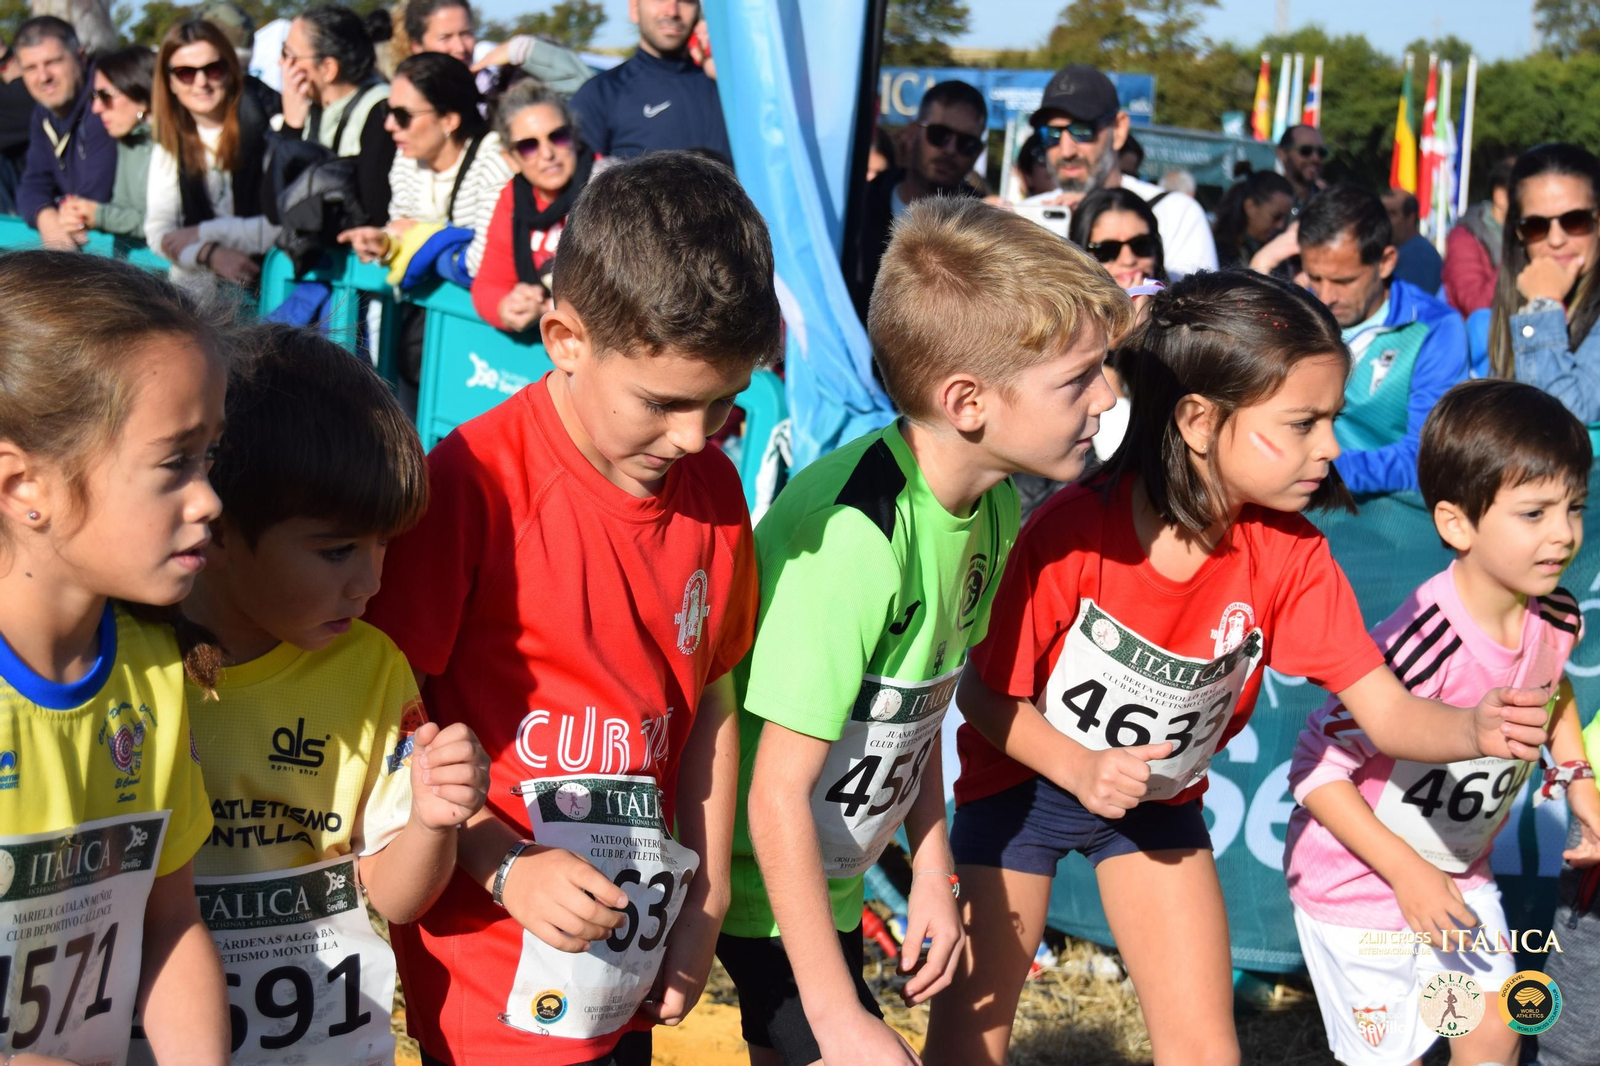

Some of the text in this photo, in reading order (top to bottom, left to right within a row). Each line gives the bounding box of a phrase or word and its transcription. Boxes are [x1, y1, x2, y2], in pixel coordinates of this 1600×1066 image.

[1129, 647, 1226, 685] ITÁLICA
[1102, 671, 1126, 690] CLUB
[1129, 685, 1142, 697] DE
[1123, 674, 1154, 693] BERTA
[869, 740, 893, 749] CLUB
[271, 764, 319, 777] sport shop
[825, 727, 942, 818] 458
[211, 799, 342, 832] ATLETISMO
[590, 834, 622, 845] MATEO
[591, 848, 614, 858] CLUB
[614, 849, 624, 859] DE
[326, 900, 348, 913] Sevilla
[12, 908, 54, 925] MARIELA
[6, 926, 32, 942] CLUB
[33, 916, 79, 937] DEPORTIVO
[286, 927, 335, 942] ALGABA
[272, 940, 339, 957] MONTILLA
